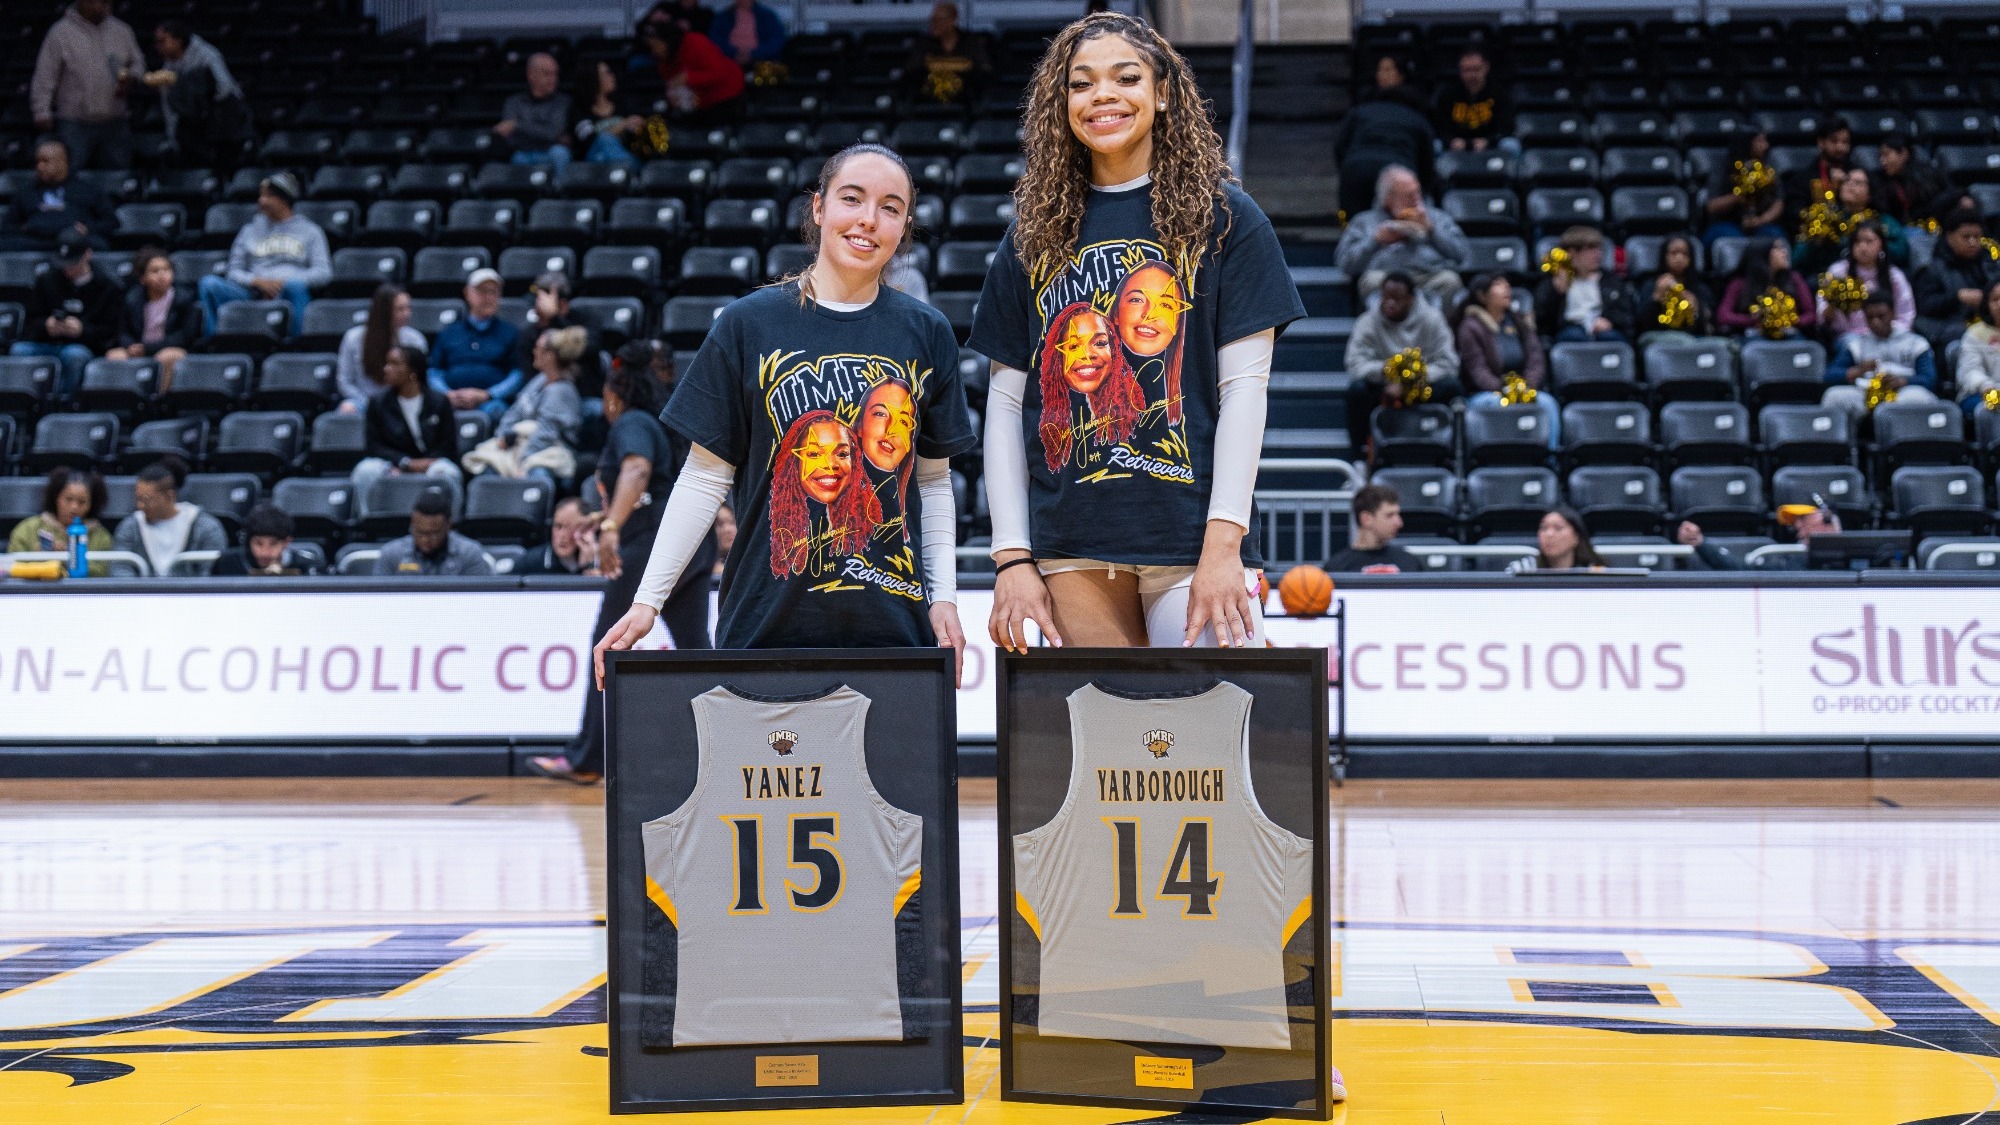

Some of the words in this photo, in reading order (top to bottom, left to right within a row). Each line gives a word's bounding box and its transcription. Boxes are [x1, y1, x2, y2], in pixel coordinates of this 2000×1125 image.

[1107, 447, 1195, 480] Retrievers
[842, 558, 923, 599] Retrievers
[0, 644, 467, 693] N-ALCOHOLIC
[1330, 643, 1687, 691] CESSIONS
[768, 730, 799, 745] UMBC
[1142, 729, 1174, 746] UMBC
[742, 765, 823, 800] YANEZ
[1096, 767, 1225, 803] YARBOROUGH
[718, 812, 847, 916] 15
[1099, 815, 1225, 921] 14
